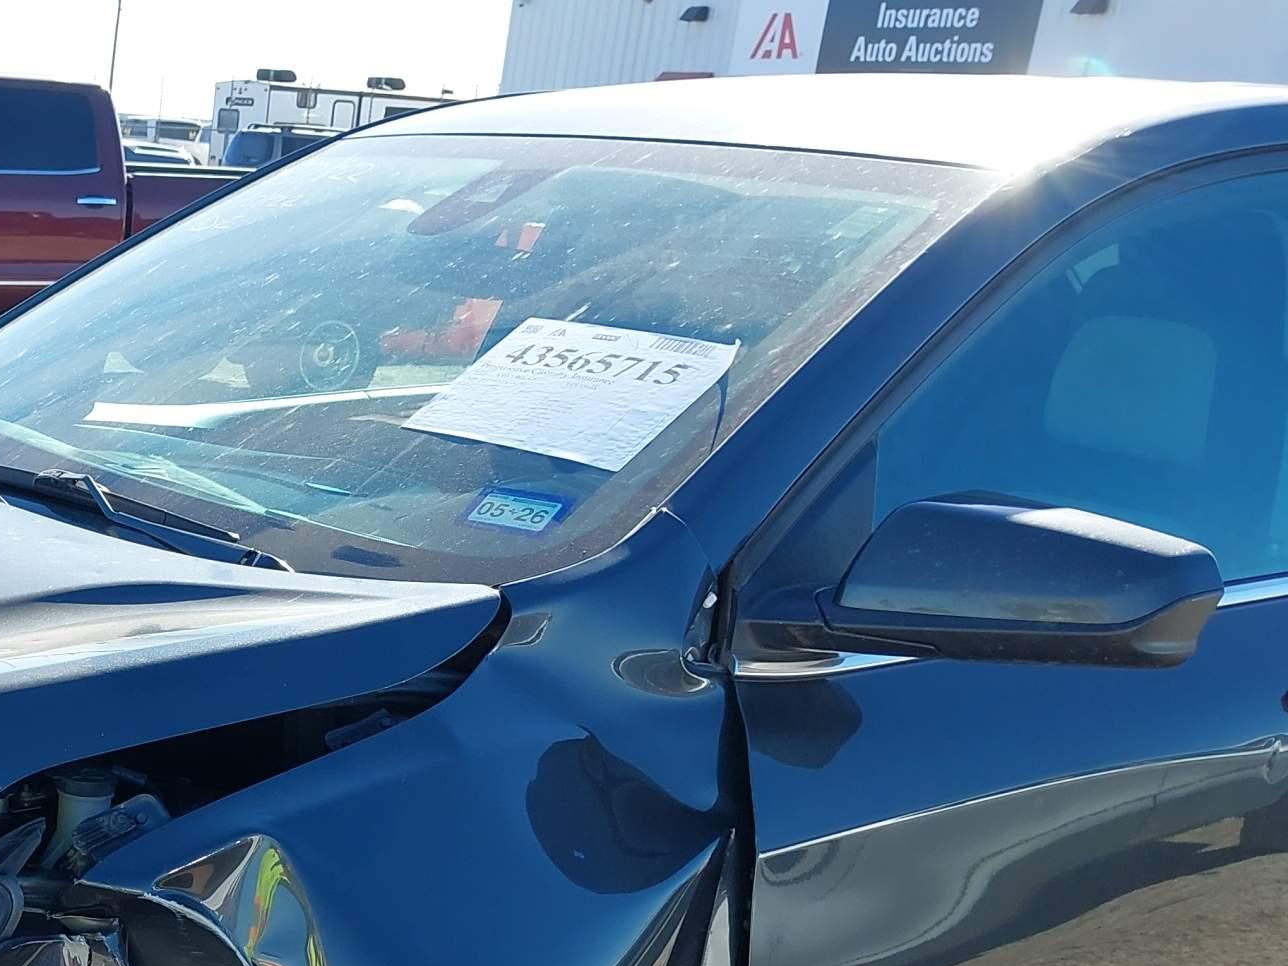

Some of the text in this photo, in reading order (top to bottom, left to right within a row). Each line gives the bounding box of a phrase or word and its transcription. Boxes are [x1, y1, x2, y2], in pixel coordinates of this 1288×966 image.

[877, 2, 980, 29] Insurance
[850, 35, 994, 63] Auto Auctions
[506, 344, 697, 385] 43565715
